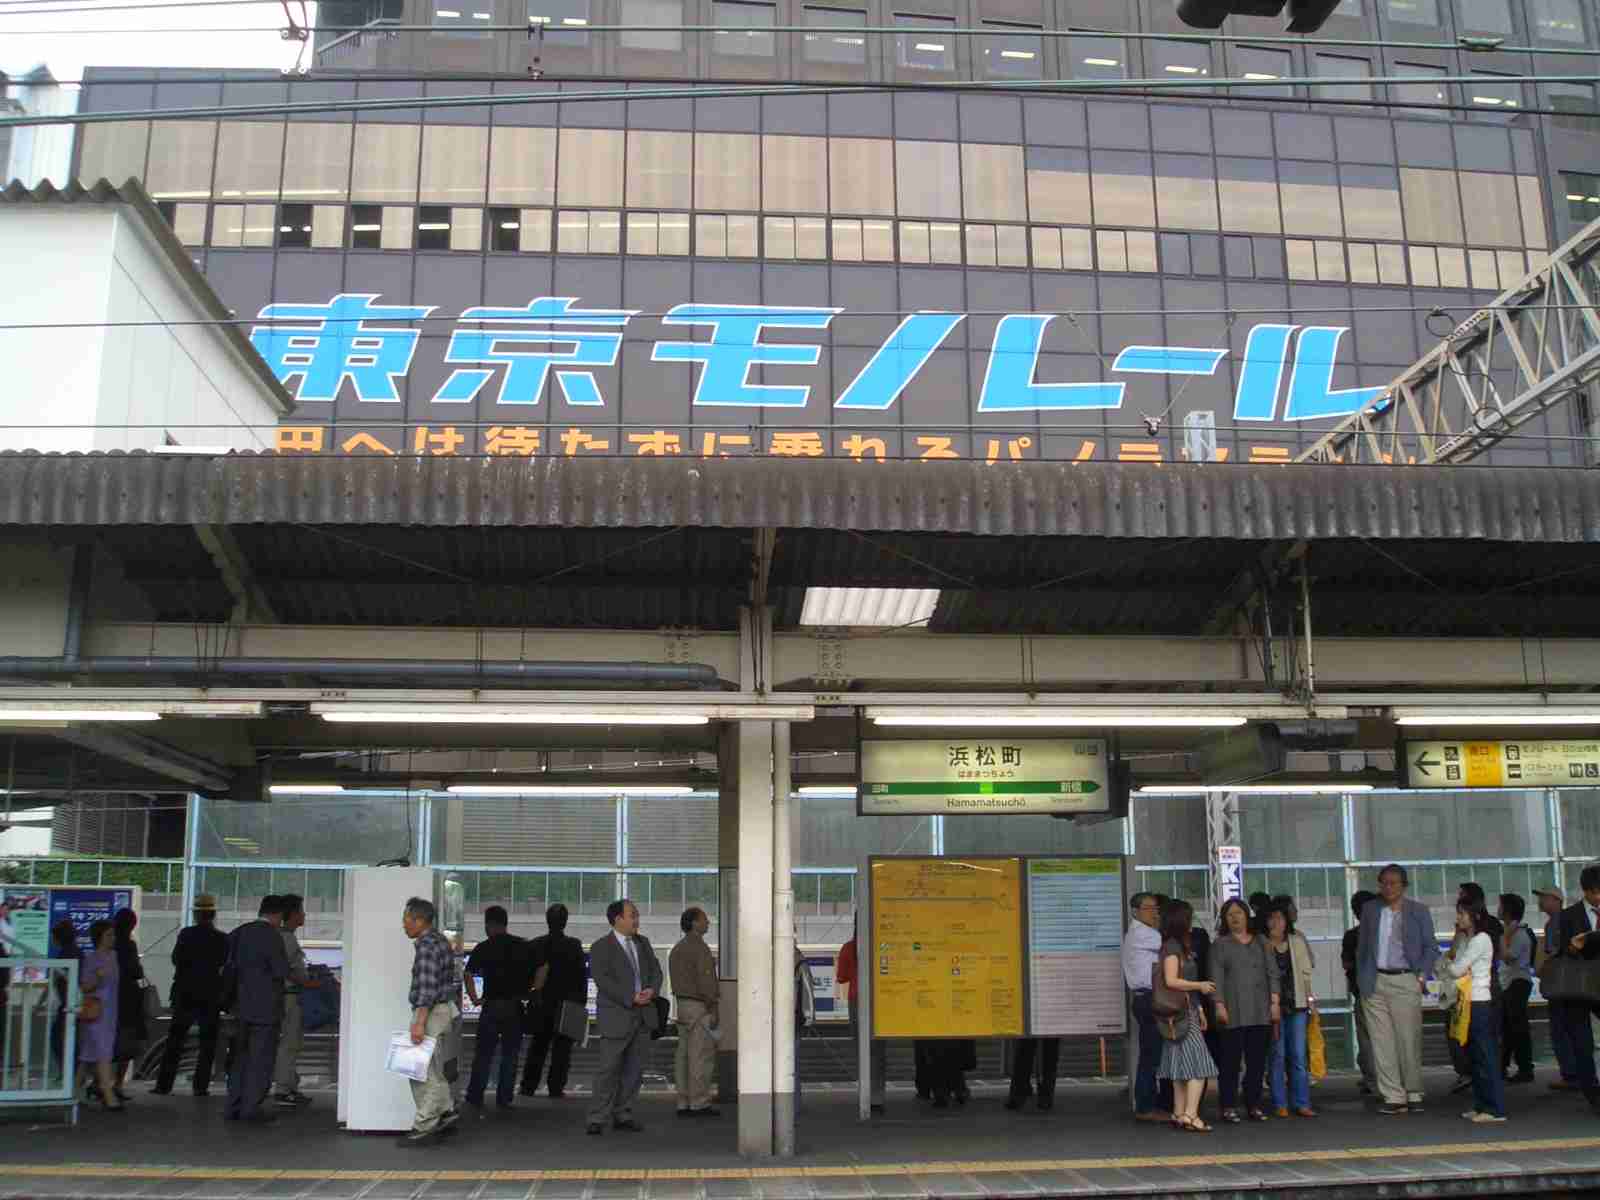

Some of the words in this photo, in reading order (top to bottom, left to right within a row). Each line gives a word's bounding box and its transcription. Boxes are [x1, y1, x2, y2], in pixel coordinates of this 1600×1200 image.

[249, 293, 1392, 422] 東京モノレール
[948, 745, 1022, 767] 浜松町
